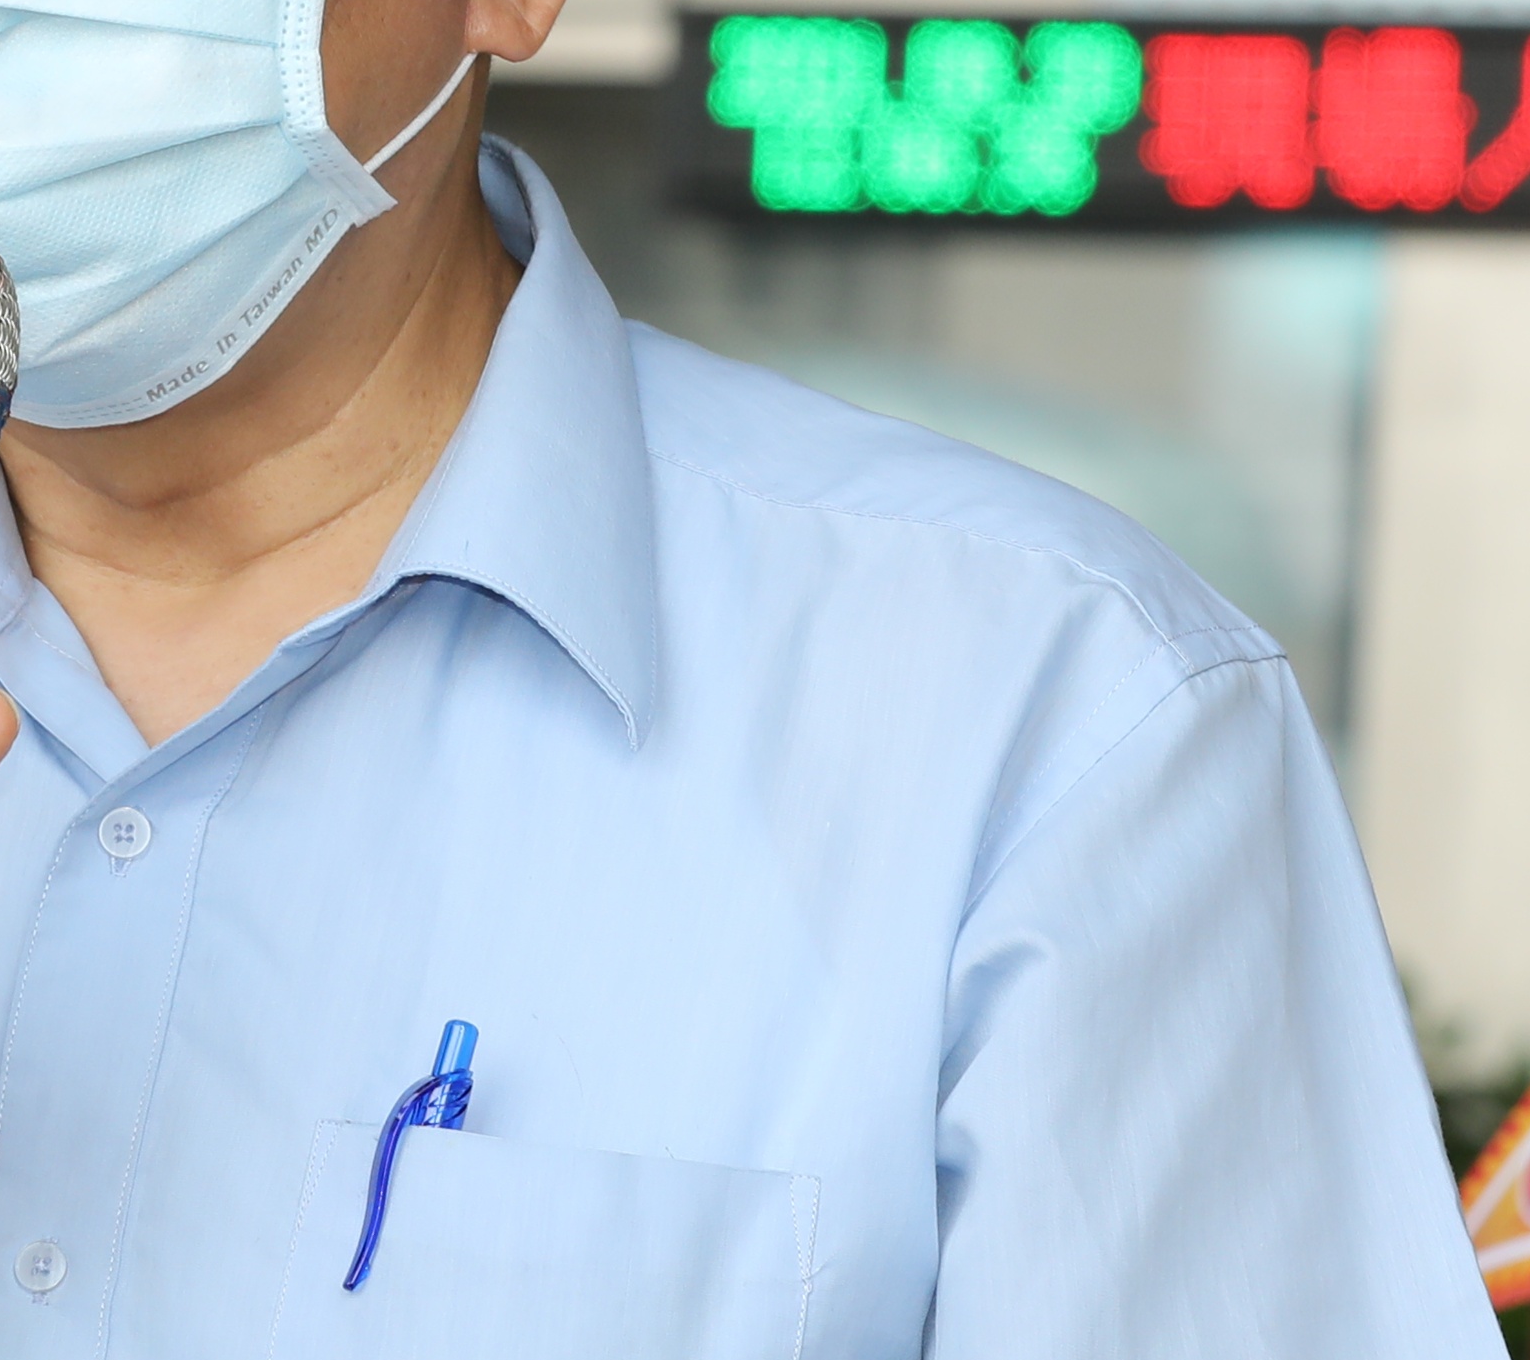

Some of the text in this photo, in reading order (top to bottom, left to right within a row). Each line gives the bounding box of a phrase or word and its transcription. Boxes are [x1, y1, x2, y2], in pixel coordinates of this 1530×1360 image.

[145, 358, 211, 404] Made
[239, 254, 304, 329] Taiwan
[303, 207, 340, 256] MD
